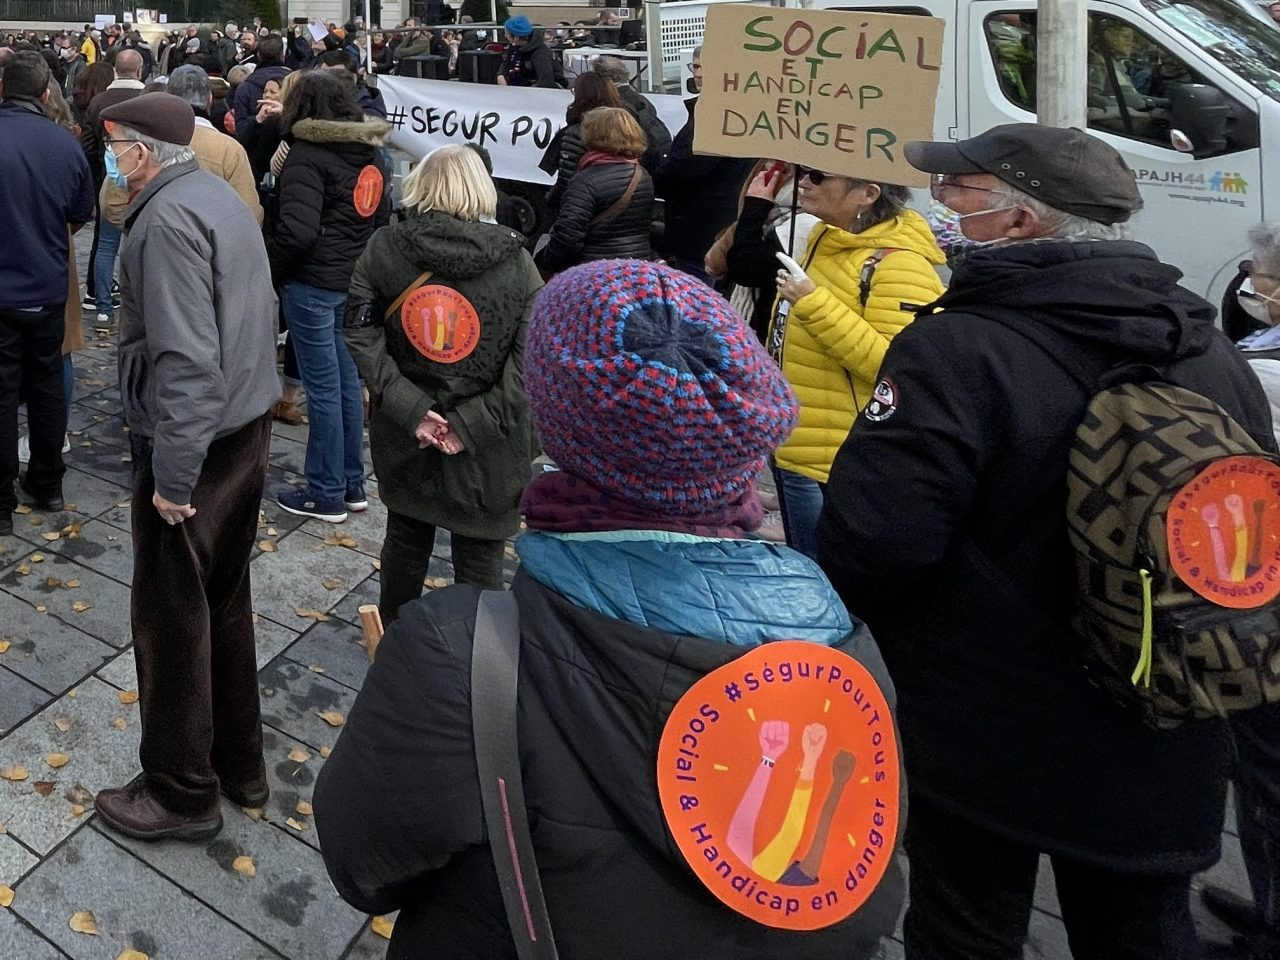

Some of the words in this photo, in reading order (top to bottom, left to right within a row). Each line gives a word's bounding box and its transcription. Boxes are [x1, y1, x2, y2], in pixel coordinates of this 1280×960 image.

[781, 56, 824, 79] ET
[722, 70, 883, 110] HANDICAP
[776, 98, 811, 117] EN
[386, 105, 501, 147] #SEGUR
[510, 115, 562, 150] PO
[721, 109, 897, 164] DANGER
[1265, 565, 1278, 582] en
[675, 703, 720, 782] Social
[724, 661, 886, 782] #SégurPourTous
[678, 794, 700, 812] &
[845, 798, 886, 892] danger
[690, 822, 800, 916] Handicap
[811, 890, 839, 910] en
